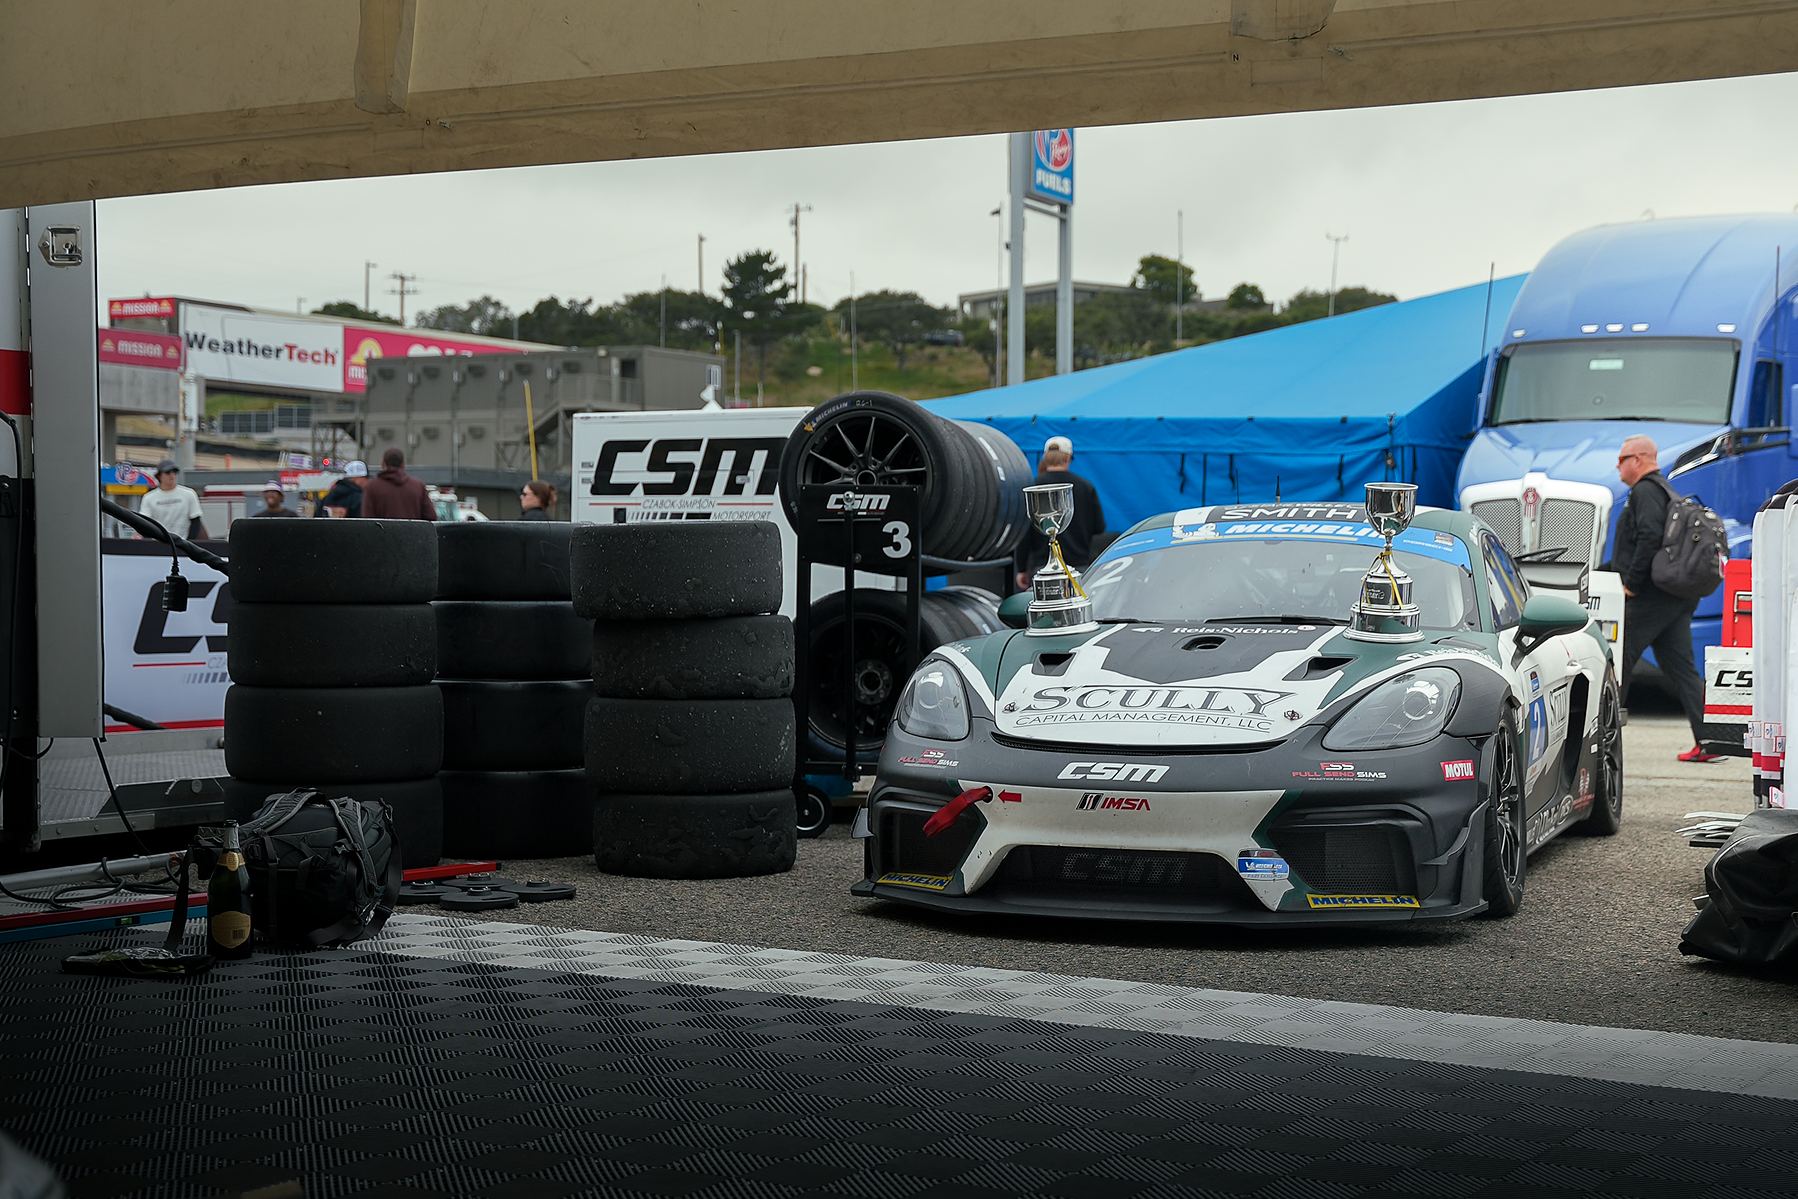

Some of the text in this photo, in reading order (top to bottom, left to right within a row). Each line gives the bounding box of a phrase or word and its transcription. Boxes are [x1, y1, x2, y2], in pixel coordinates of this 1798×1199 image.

[1036, 168, 1071, 195] FUELS
[185, 332, 336, 367] WeatherTech
[590, 437, 788, 496] CSM
[642, 499, 715, 509] CZABOK-SIMPSON
[713, 511, 771, 520] MOTORSPORT
[1221, 507, 1358, 519] SMITH
[882, 521, 911, 558] 3
[1089, 556, 1133, 588] 2
[1020, 685, 1297, 717] SCULLY
[1015, 712, 1271, 731] CAPITAL MANAGEMENT, LLC
[1532, 702, 1540, 760] 2
[937, 759, 959, 767] SIMS
[1444, 762, 1474, 778] MOTUL
[1057, 761, 1170, 783] CSM
[1356, 771, 1387, 779] SIMS
[1100, 797, 1151, 811] IMSA
[884, 874, 947, 887] MICHELIN
[1311, 897, 1415, 905] MICHELIN
